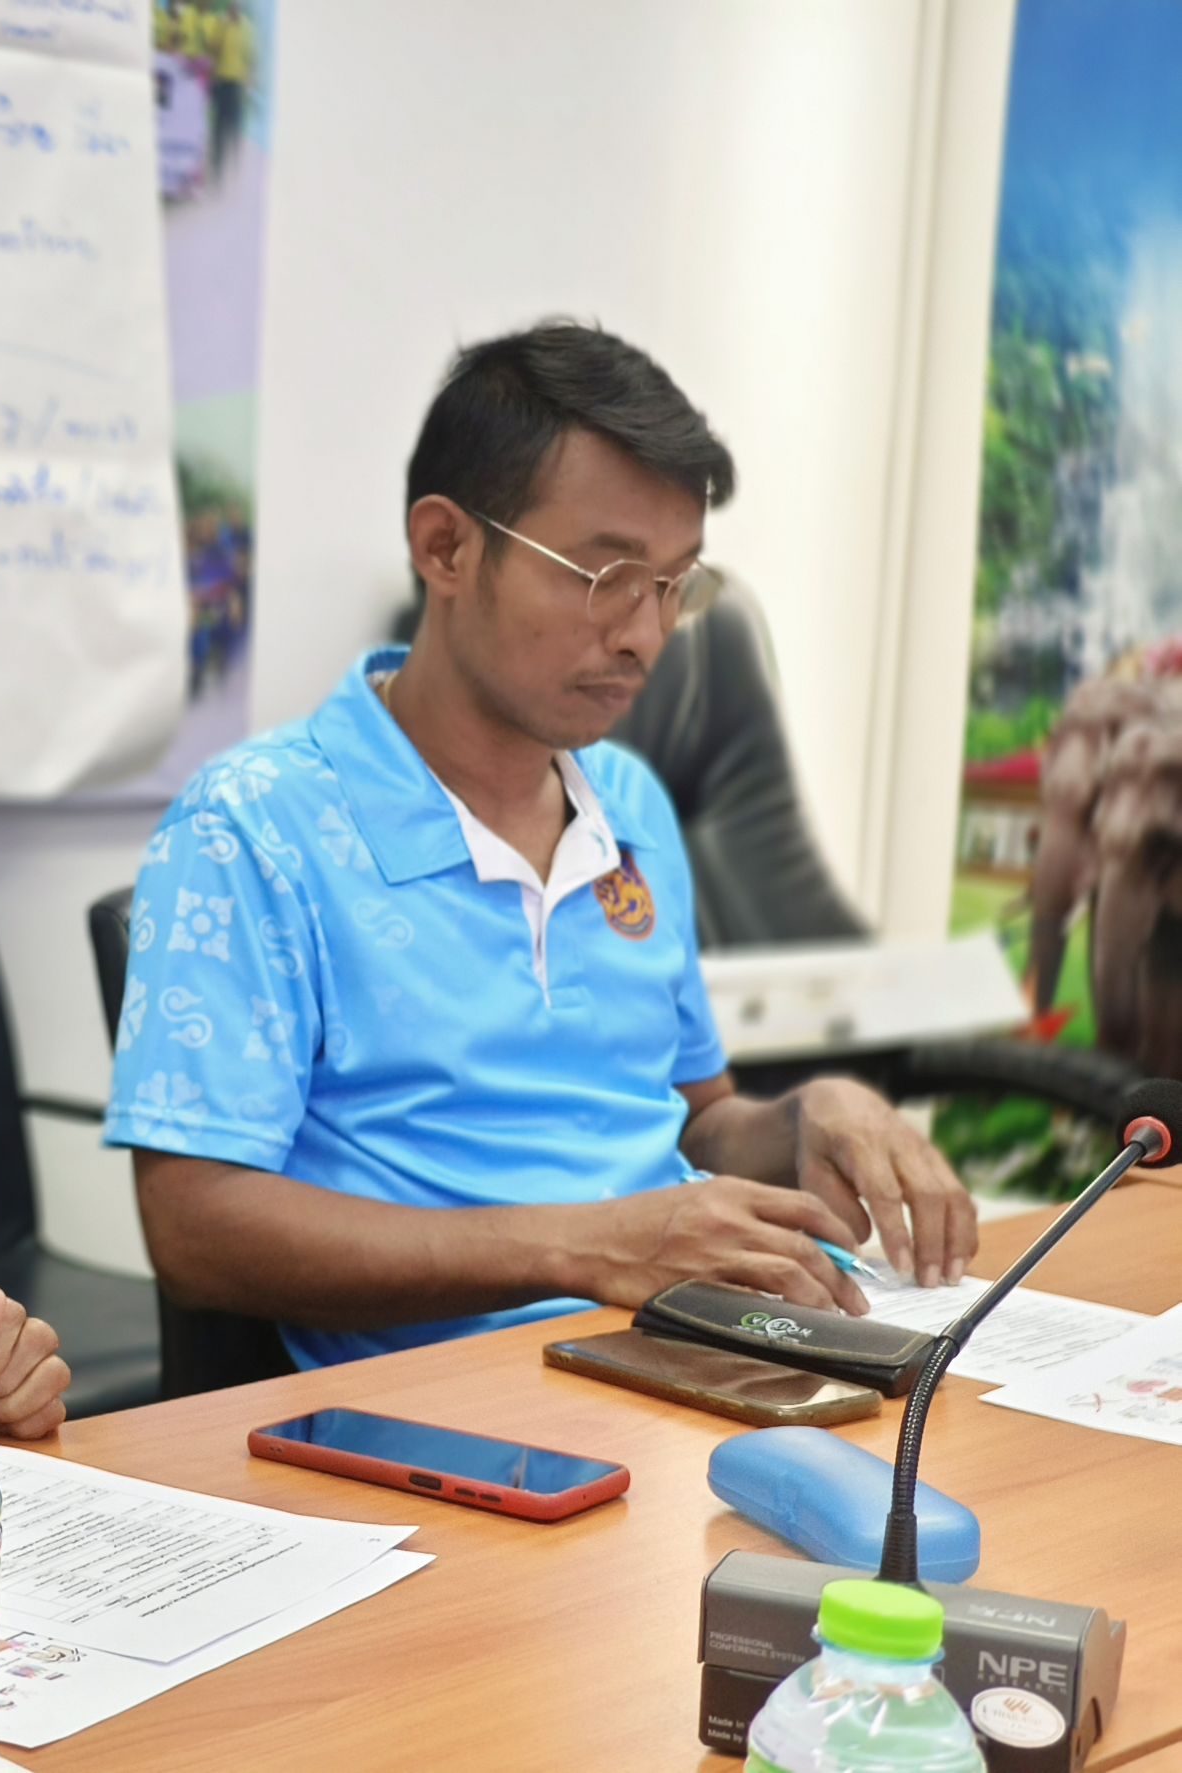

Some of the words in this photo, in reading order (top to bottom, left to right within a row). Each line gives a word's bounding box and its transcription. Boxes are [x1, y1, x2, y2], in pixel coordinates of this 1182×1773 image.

[709, 1631, 774, 1650] PROFESSIONAL
[709, 1640, 767, 1659] CONFERENCE
[769, 1650, 806, 1663] SYSTEM
[978, 1650, 1068, 1687] NPE
[977, 1672, 1067, 1696] RESEARCH
[708, 1715, 733, 1728] Made
[707, 1729, 731, 1740] Made
